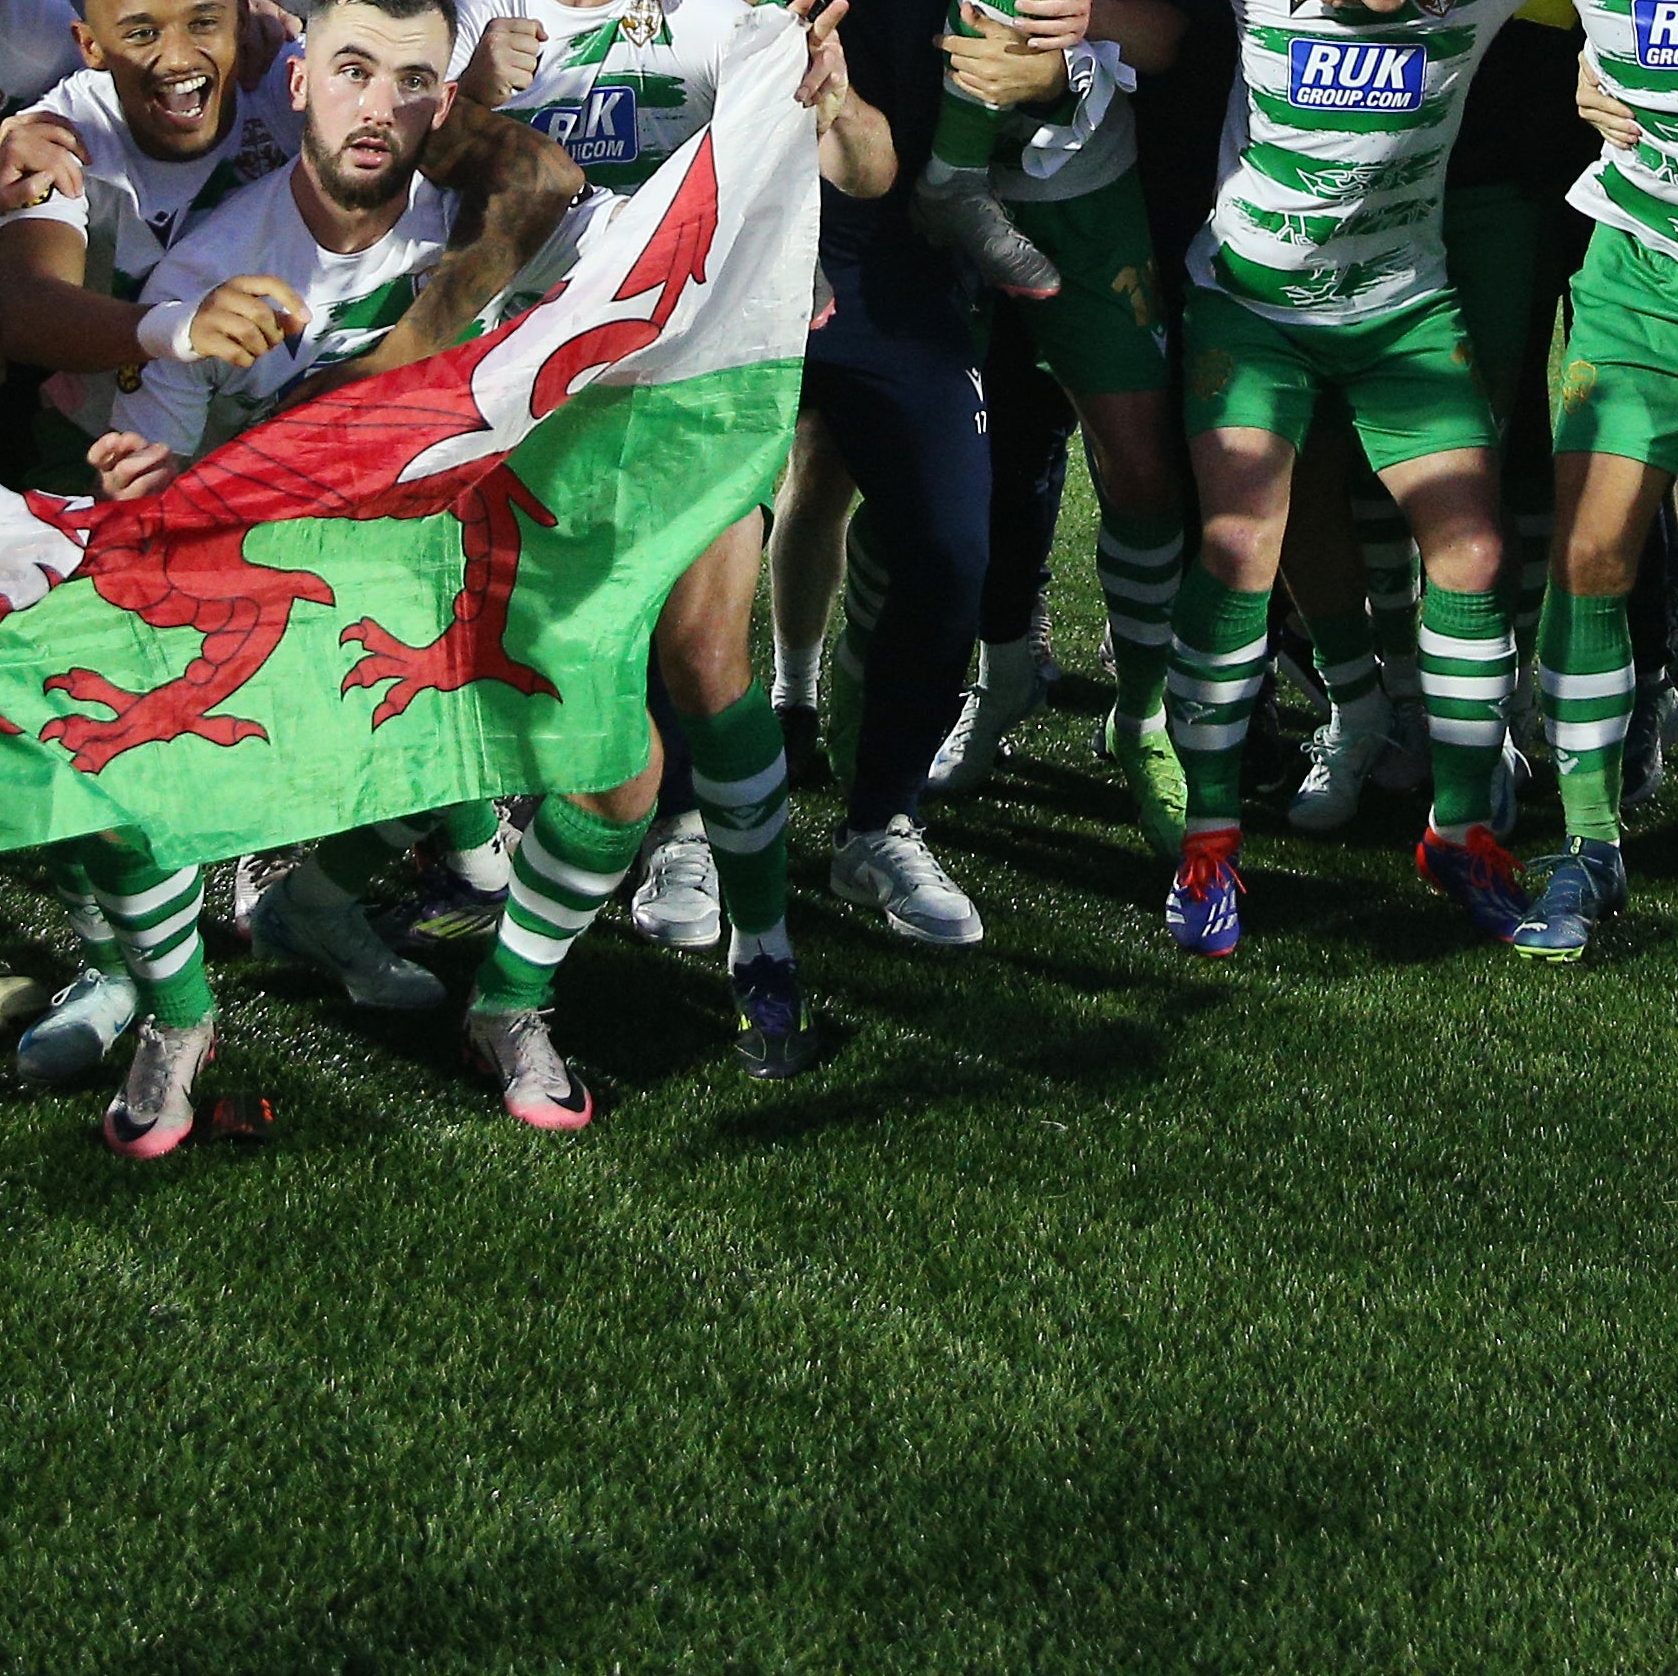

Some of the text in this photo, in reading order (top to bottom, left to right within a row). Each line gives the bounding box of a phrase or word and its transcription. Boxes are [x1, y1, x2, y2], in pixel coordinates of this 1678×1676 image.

[1301, 44, 1416, 89] RUK
[1296, 87, 1413, 108] GROUP.COM
[974, 410, 987, 435] 17
